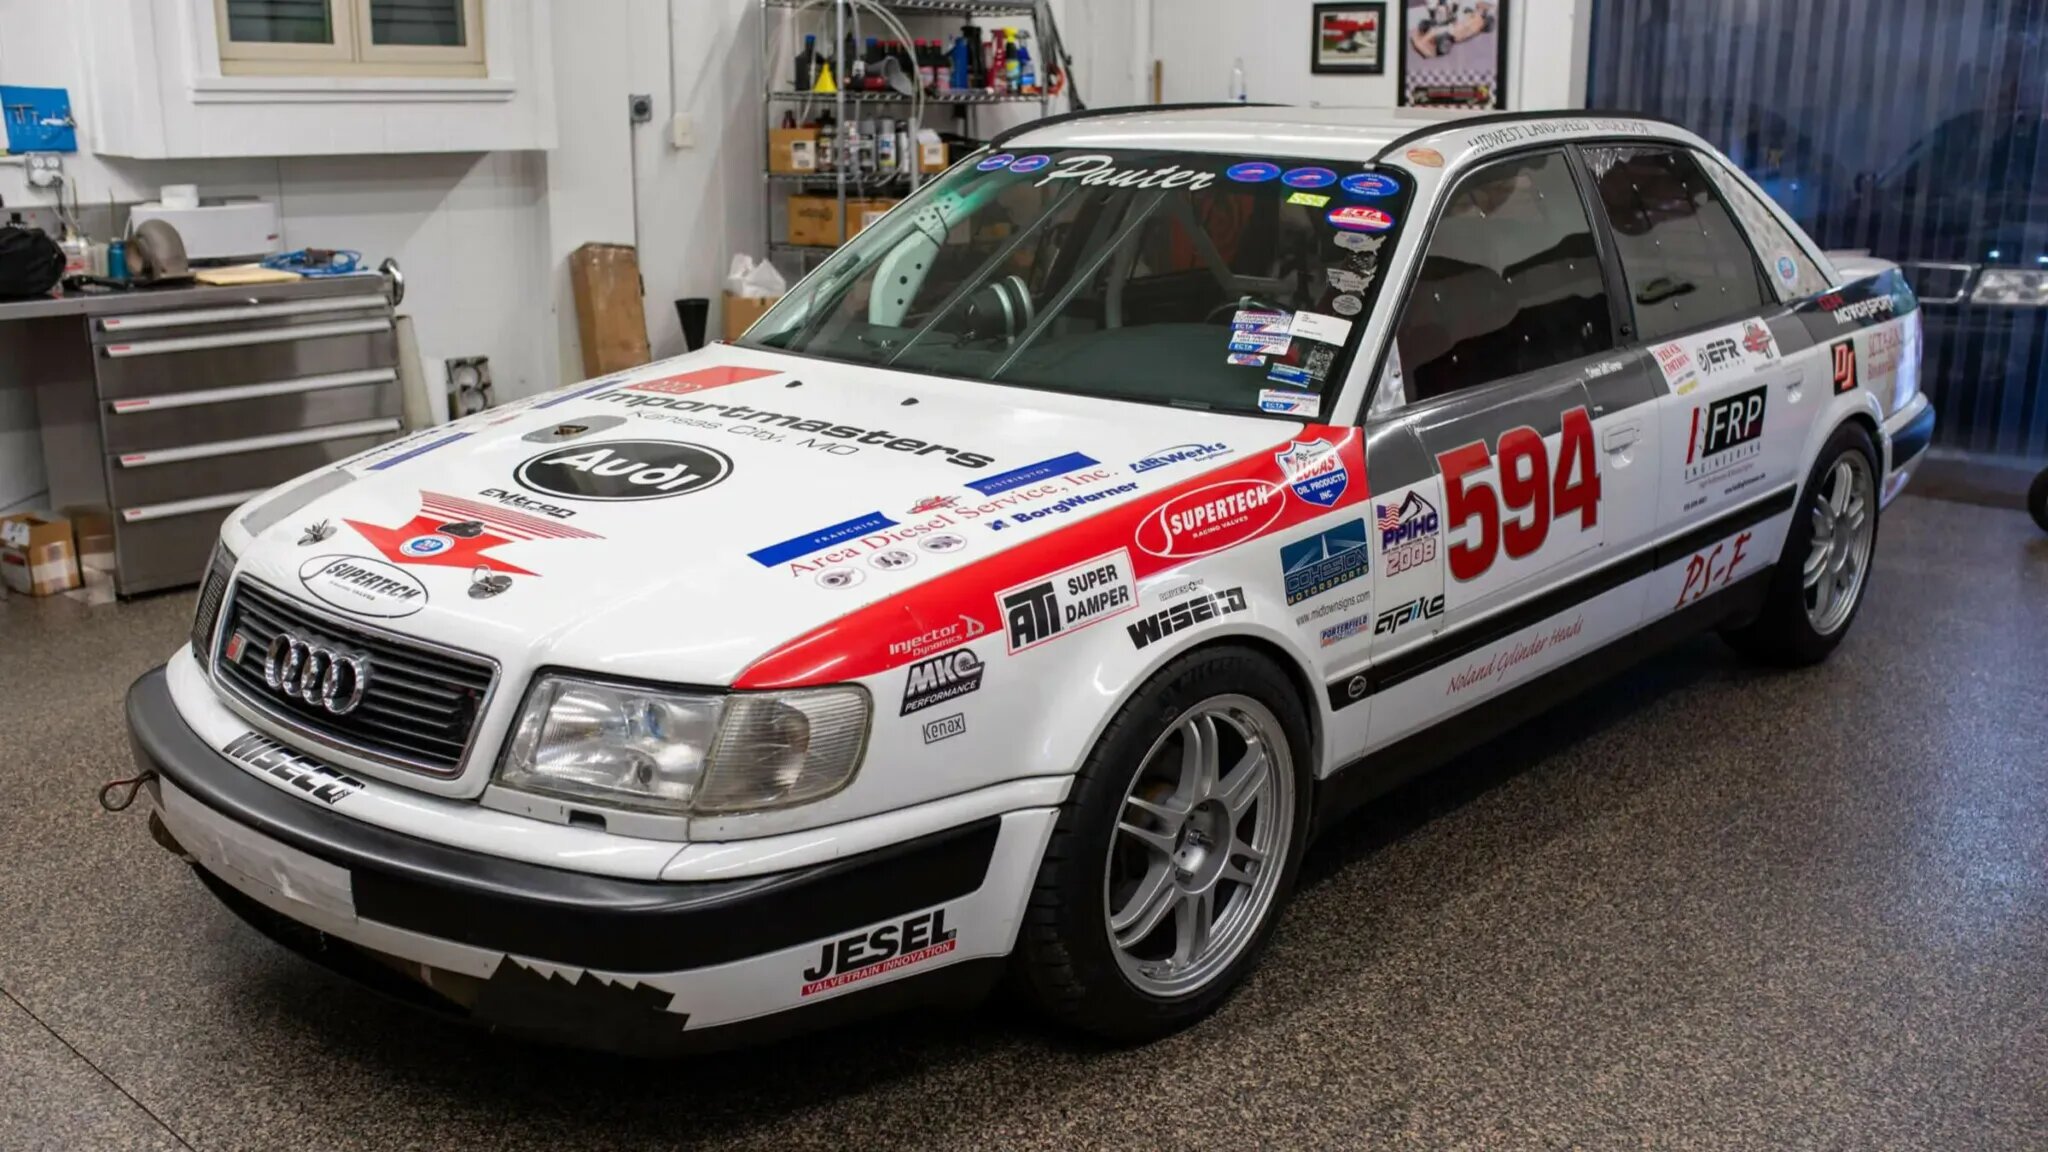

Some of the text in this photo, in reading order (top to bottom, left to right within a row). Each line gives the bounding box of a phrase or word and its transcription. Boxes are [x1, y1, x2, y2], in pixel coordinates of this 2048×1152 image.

[1034, 154, 1216, 191] Pauter
[1834, 344, 1855, 390] DJ
[583, 388, 995, 469] Importmasters
[628, 409, 860, 456] Kansas City, MO
[1710, 395, 1763, 451] FRP
[541, 449, 702, 490] Audi
[984, 467, 1052, 491] DISTRIBUTOR
[1296, 472, 1346, 495] OIL PRODUCTS
[1011, 481, 1139, 523] BorgWarner
[1170, 484, 1269, 535] SUPERTECH
[1434, 405, 1602, 583] 594
[789, 469, 1120, 578] Area Diesel Service, Inc.
[814, 519, 882, 544] FRANCHISE
[1285, 547, 1369, 593] COHESION
[1386, 537, 1437, 577] 2008
[326, 562, 423, 599] SUPERTECH
[1067, 564, 1118, 596] SUPER
[1287, 565, 1369, 604] MOTORSPORTS
[1003, 581, 1062, 649] ATI
[1065, 584, 1130, 624] DAMPER
[889, 622, 960, 656] Injector
[912, 635, 963, 657] Dynamics
[1321, 614, 1368, 640] PORTERFIELD
[1446, 614, 1584, 696] Noland Cylinder Heads
[904, 679, 978, 713] PERFORMANCE
[803, 908, 957, 982] JESEL
[806, 943, 951, 995] VALVETRAIN INNOVATION
